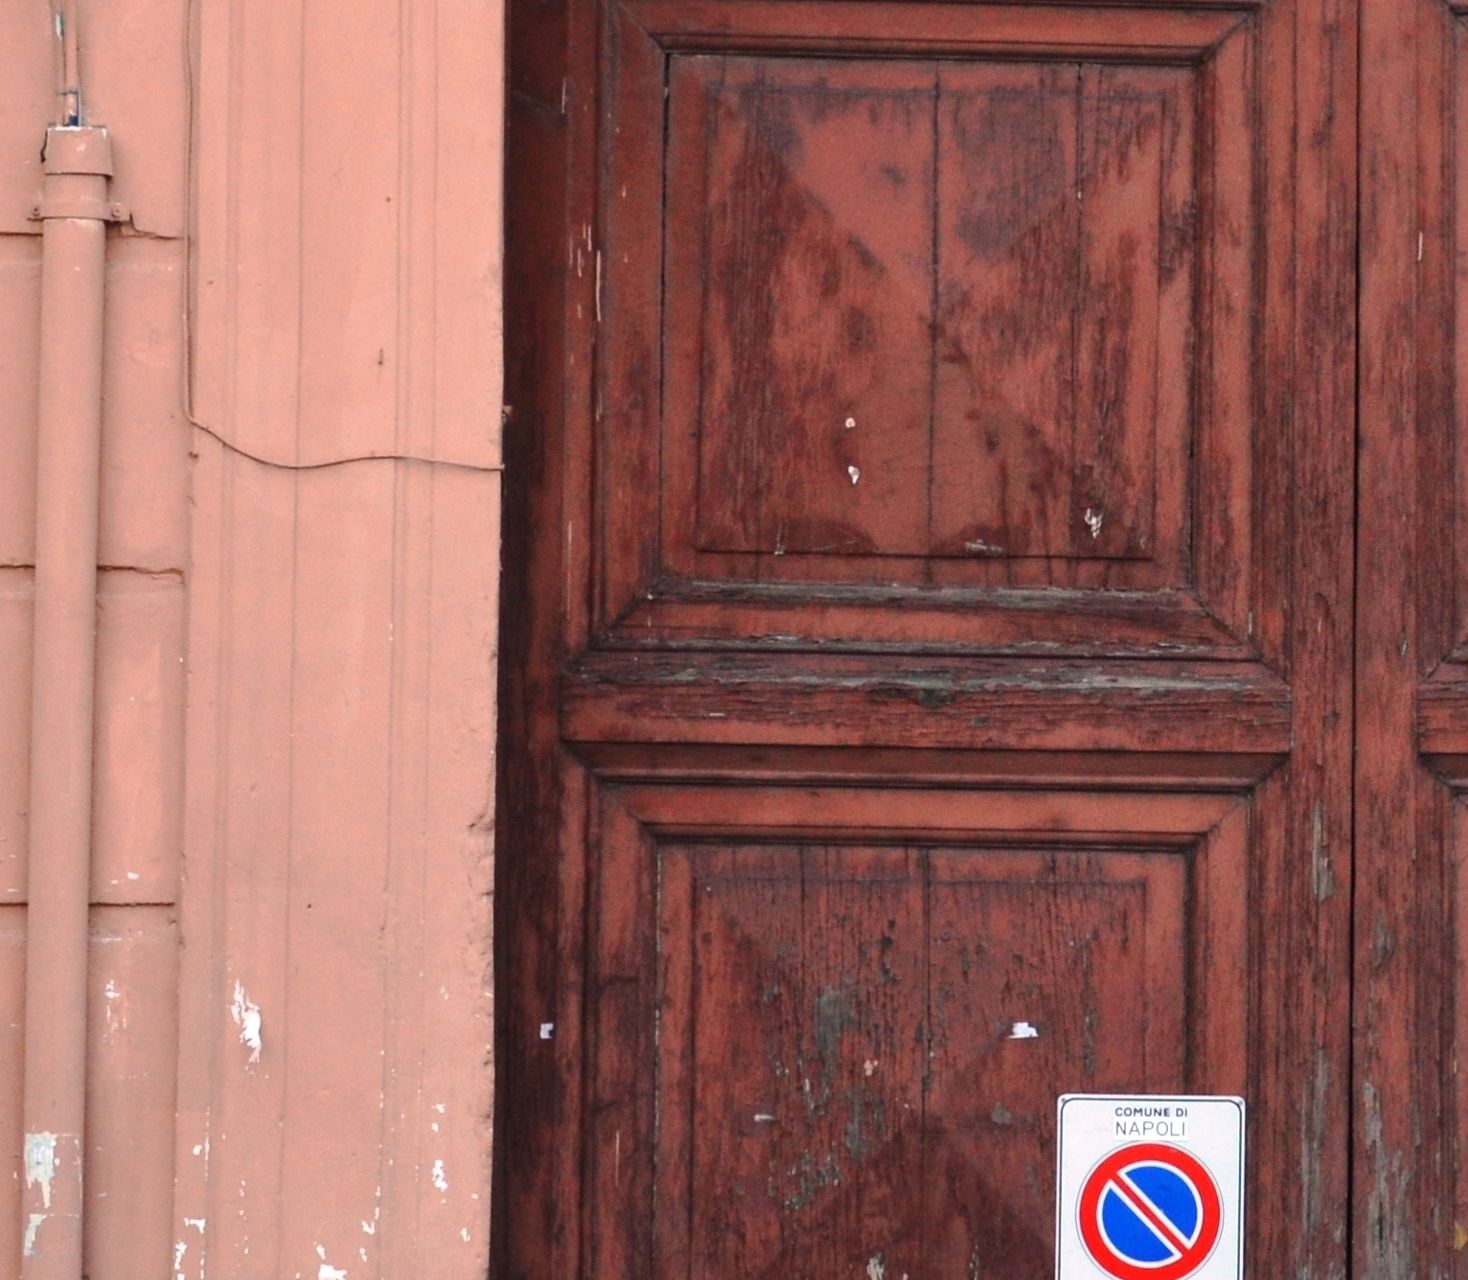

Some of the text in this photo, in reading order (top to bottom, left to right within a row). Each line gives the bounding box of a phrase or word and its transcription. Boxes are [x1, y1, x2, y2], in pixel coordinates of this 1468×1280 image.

[1115, 1107, 1188, 1117] COMUNE DI
[1115, 1121, 1185, 1137] NAPOLI
